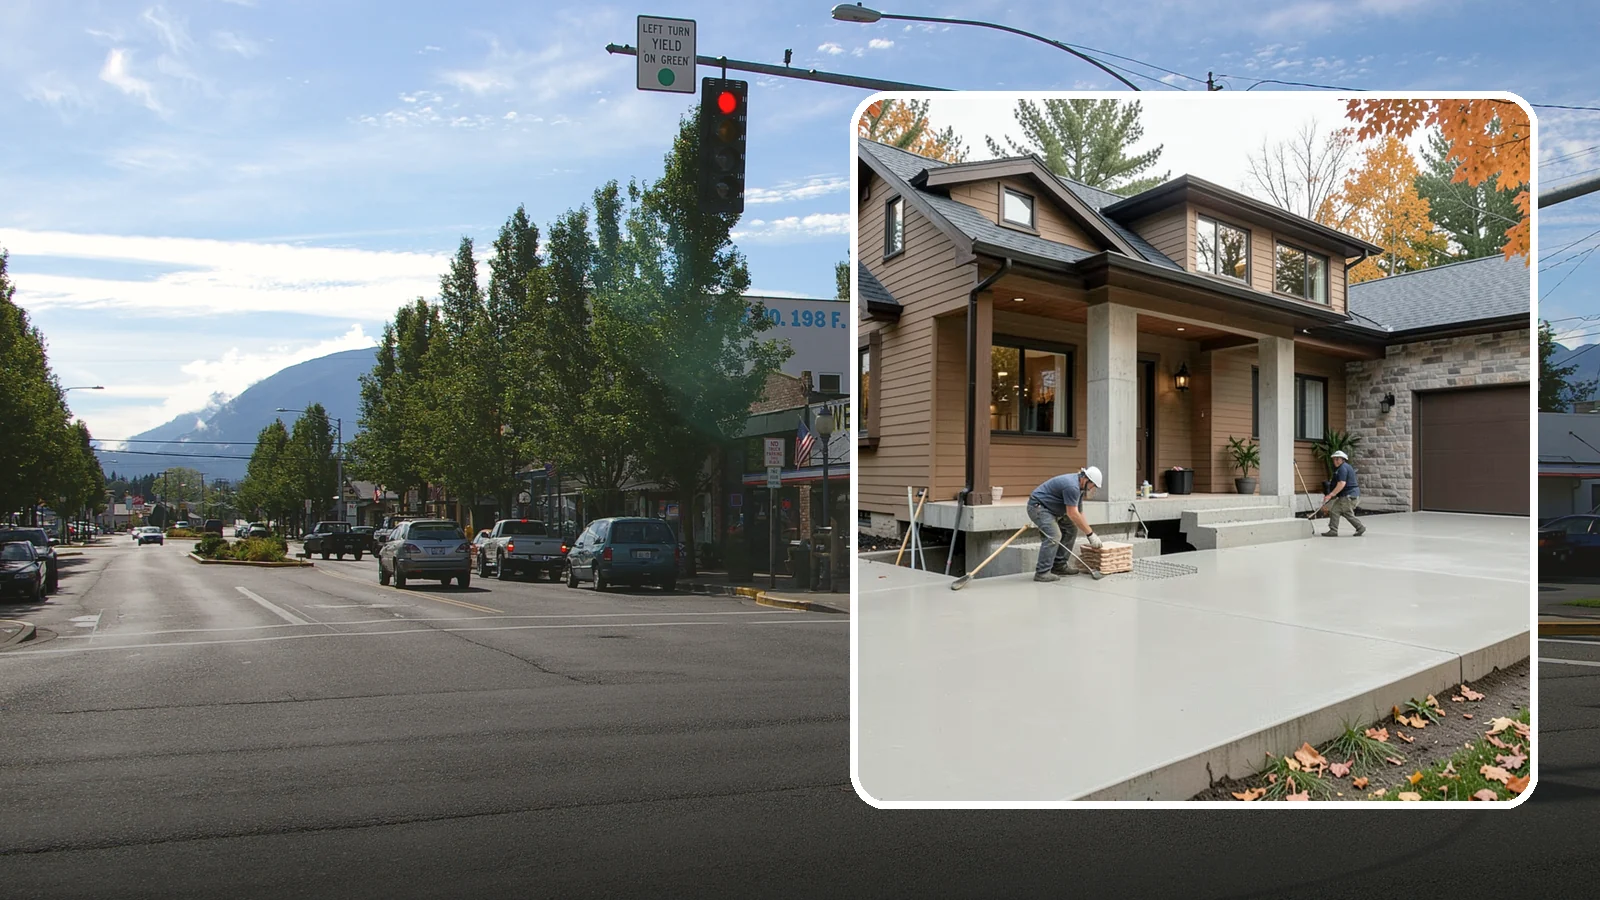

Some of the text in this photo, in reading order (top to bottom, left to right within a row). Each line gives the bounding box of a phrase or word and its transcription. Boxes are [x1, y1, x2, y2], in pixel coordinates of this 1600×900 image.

[643, 23, 690, 37] LEFT TURN
[652, 38, 682, 52] YIELD
[644, 53, 689, 66] ON GREEN
[791, 309, 826, 328] 198
[831, 311, 846, 329] F.
